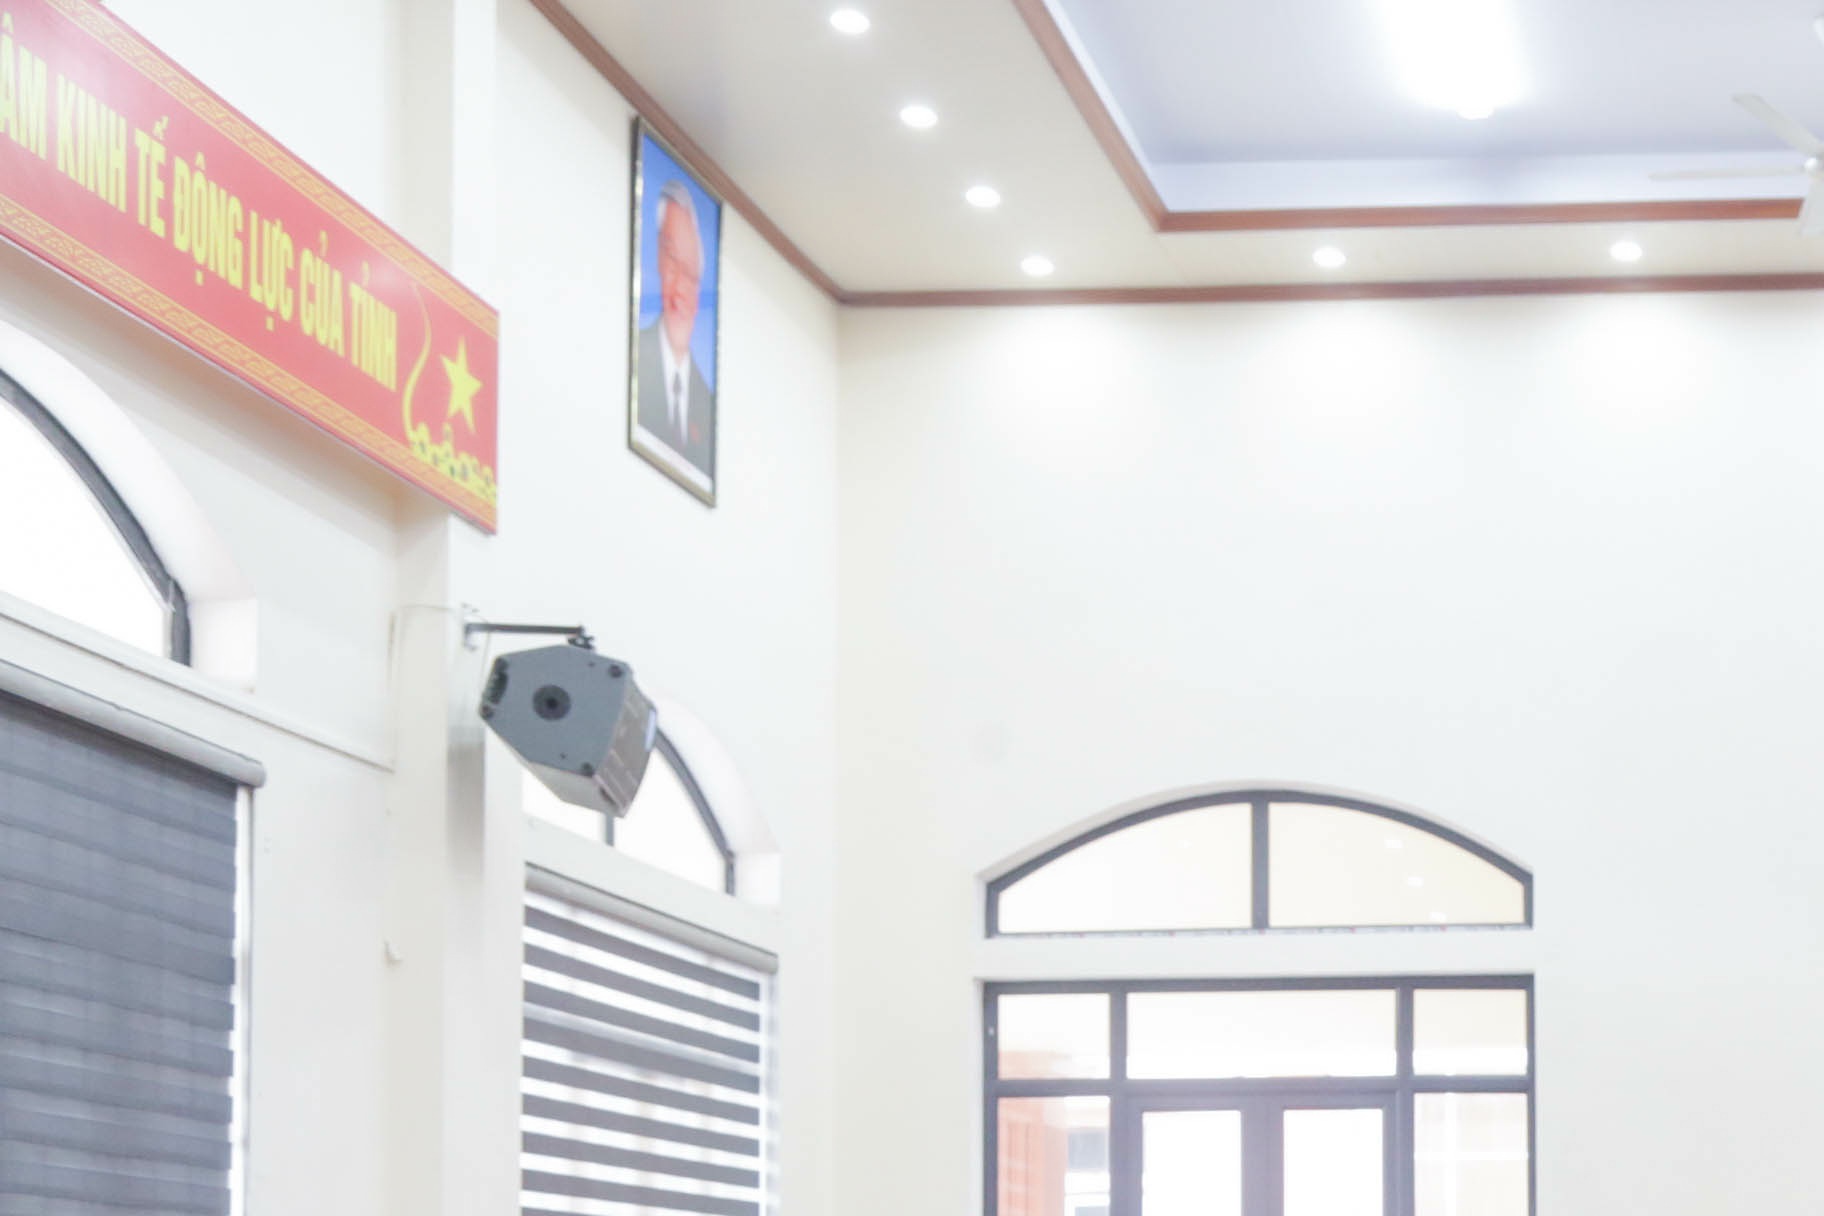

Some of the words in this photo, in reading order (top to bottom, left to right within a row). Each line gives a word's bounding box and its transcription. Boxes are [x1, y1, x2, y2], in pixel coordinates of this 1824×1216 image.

[56, 73, 128, 213] KINH
[134, 115, 168, 239] TẾ
[173, 151, 243, 289] ĐỘNG
[250, 209, 294, 332] LỰC
[301, 230, 345, 358] CỦA
[350, 261, 398, 393] TỈNH
